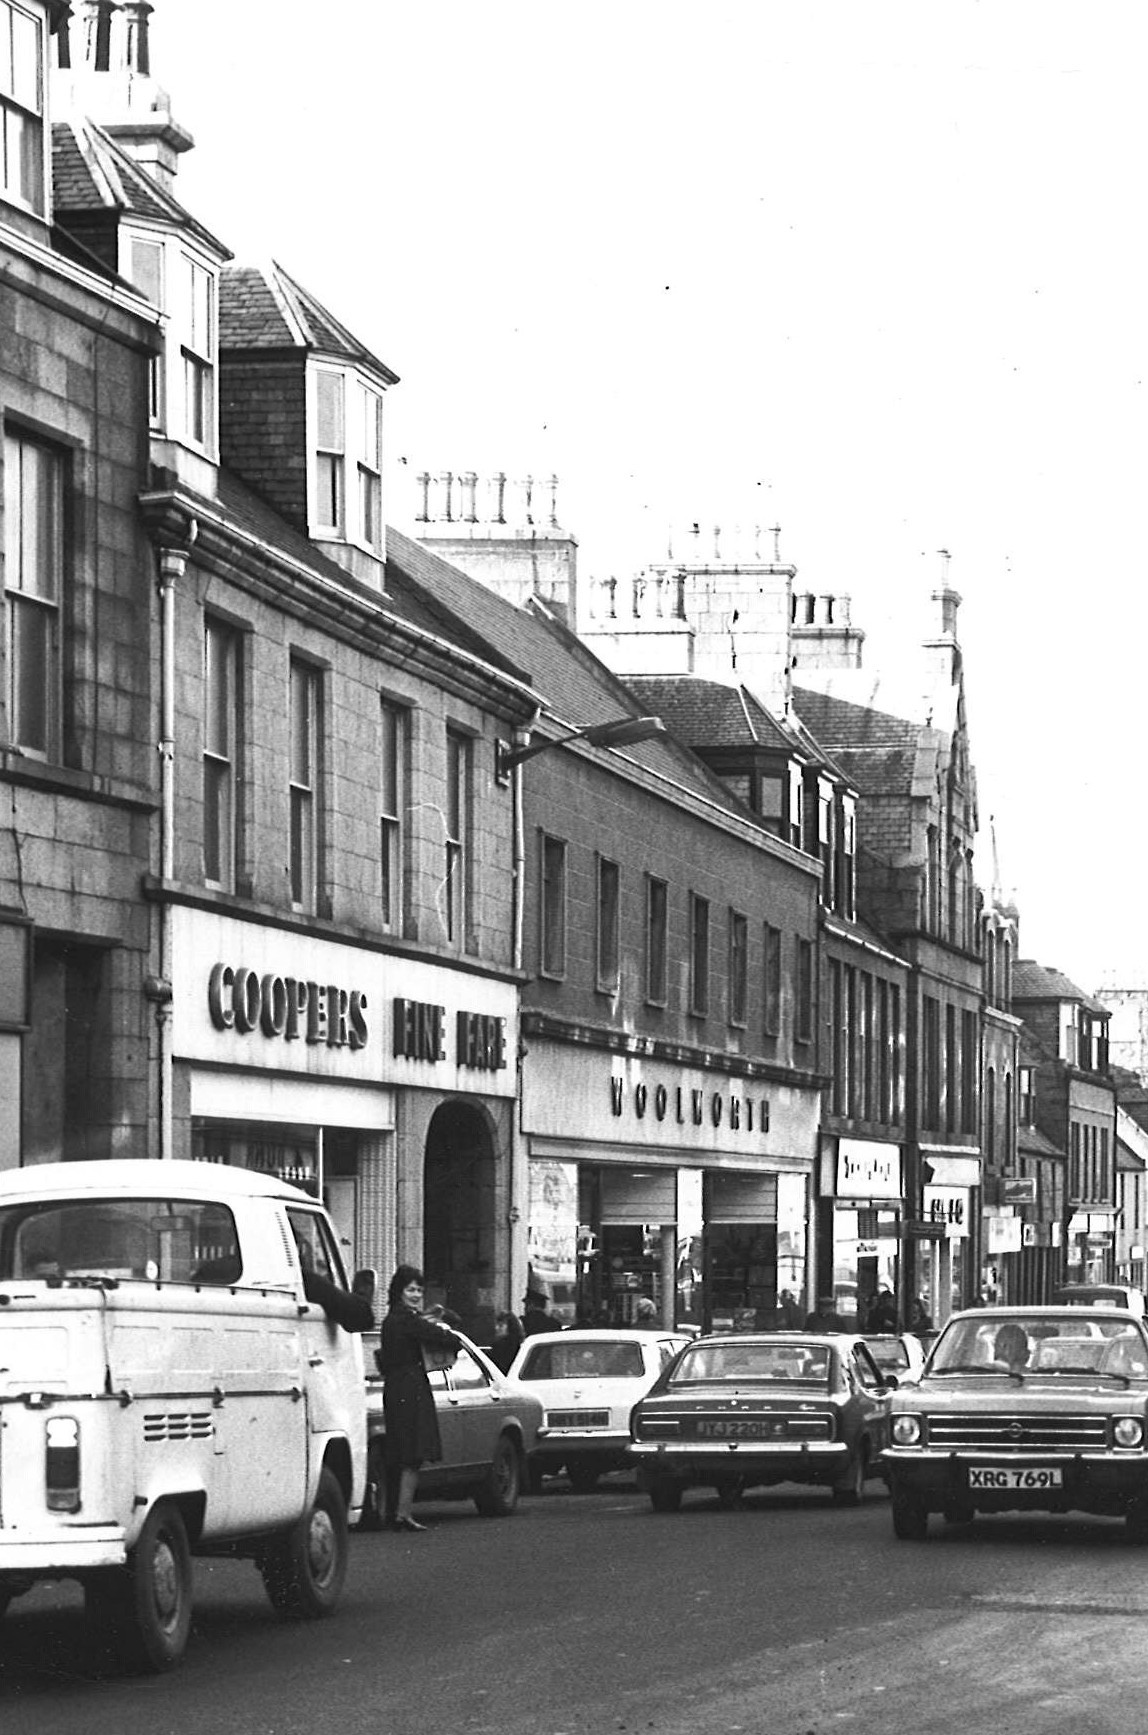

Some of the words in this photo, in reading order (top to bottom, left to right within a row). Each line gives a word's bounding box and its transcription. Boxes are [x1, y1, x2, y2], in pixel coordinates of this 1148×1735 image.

[208, 962, 368, 1050] COOPERS
[393, 997, 446, 1064] FINE
[456, 1010, 507, 1073] FARE
[611, 1076, 769, 1133] WOOLWORTH
[970, 1470, 1008, 1487] XRG
[1011, 1471, 1062, 1487] 769L
